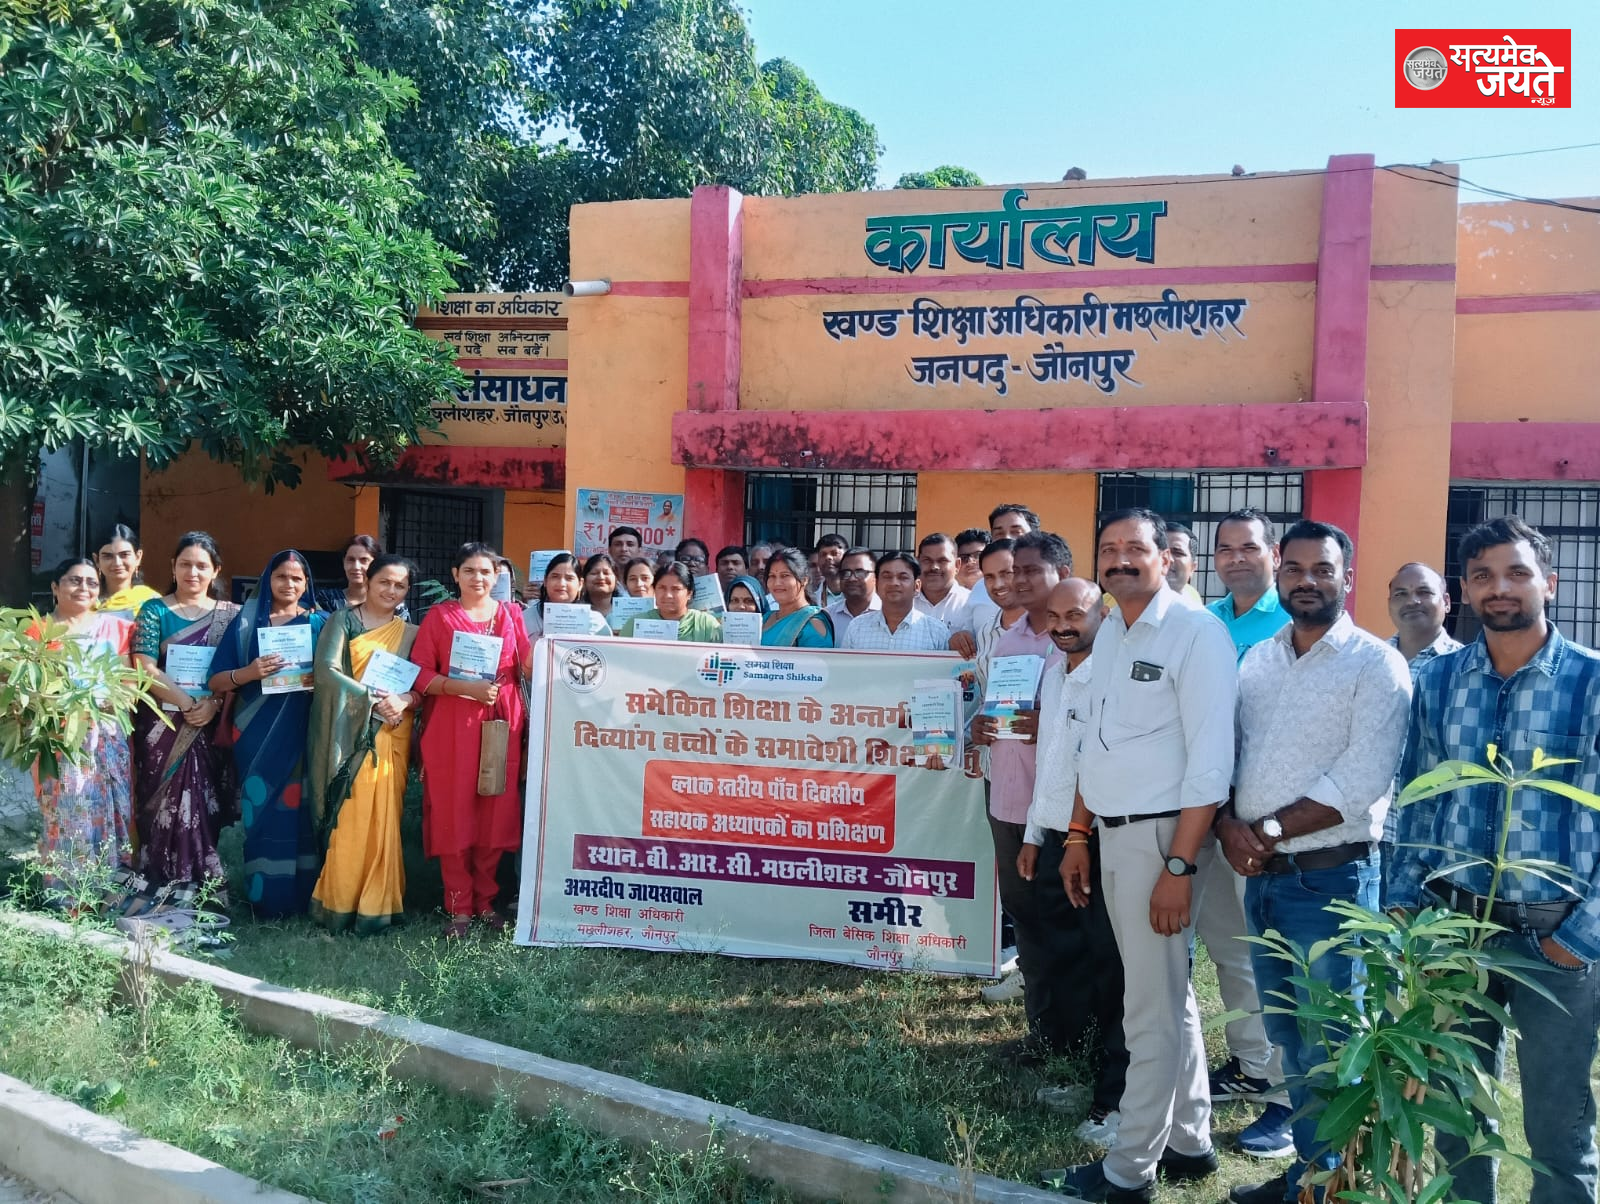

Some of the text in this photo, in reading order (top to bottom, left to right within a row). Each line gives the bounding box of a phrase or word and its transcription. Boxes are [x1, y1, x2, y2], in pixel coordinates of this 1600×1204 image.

[864, 188, 1168, 273] कार्यालय
[475, 301, 496, 315] का
[497, 294, 563, 317] अधिकार
[823, 309, 904, 341] खण्ड
[907, 297, 987, 345] शिक्षा
[987, 291, 1108, 338] अधिकारी
[464, 331, 491, 344] शिक्षा
[497, 330, 551, 343] अभियान
[497, 345, 518, 356] सब
[904, 353, 1009, 395] जनपद
[1026, 342, 1144, 392] जौनपुर
[743, 671, 823, 682] Samagra Shiksha
[744, 659, 795, 671] समग्र शिक्षा
[625, 688, 717, 718] समेकित
[723, 692, 792, 723] शिक्षा
[798, 696, 823, 723] के
[574, 720, 657, 752] दिव्यांग
[662, 727, 723, 756] बच्चों
[724, 730, 749, 757] के
[755, 733, 858, 765] समावेशी
[671, 775, 714, 795] ब्लाक
[717, 774, 763, 799] स्तरीय
[801, 778, 865, 806] दिवसीय
[650, 809, 886, 845] सहायक अध्यापकों का प्रशिक्षण
[564, 876, 703, 906] अमरदीप जायसवाल
[573, 903, 685, 923] खण्ड शिक्षा अधिकारी
[848, 897, 922, 928] समीर
[641, 924, 679, 945] जौनपुर
[809, 923, 968, 950] जिला बेसिक शिक्षा अधिकारी
[866, 944, 905, 967] जौनपुर
